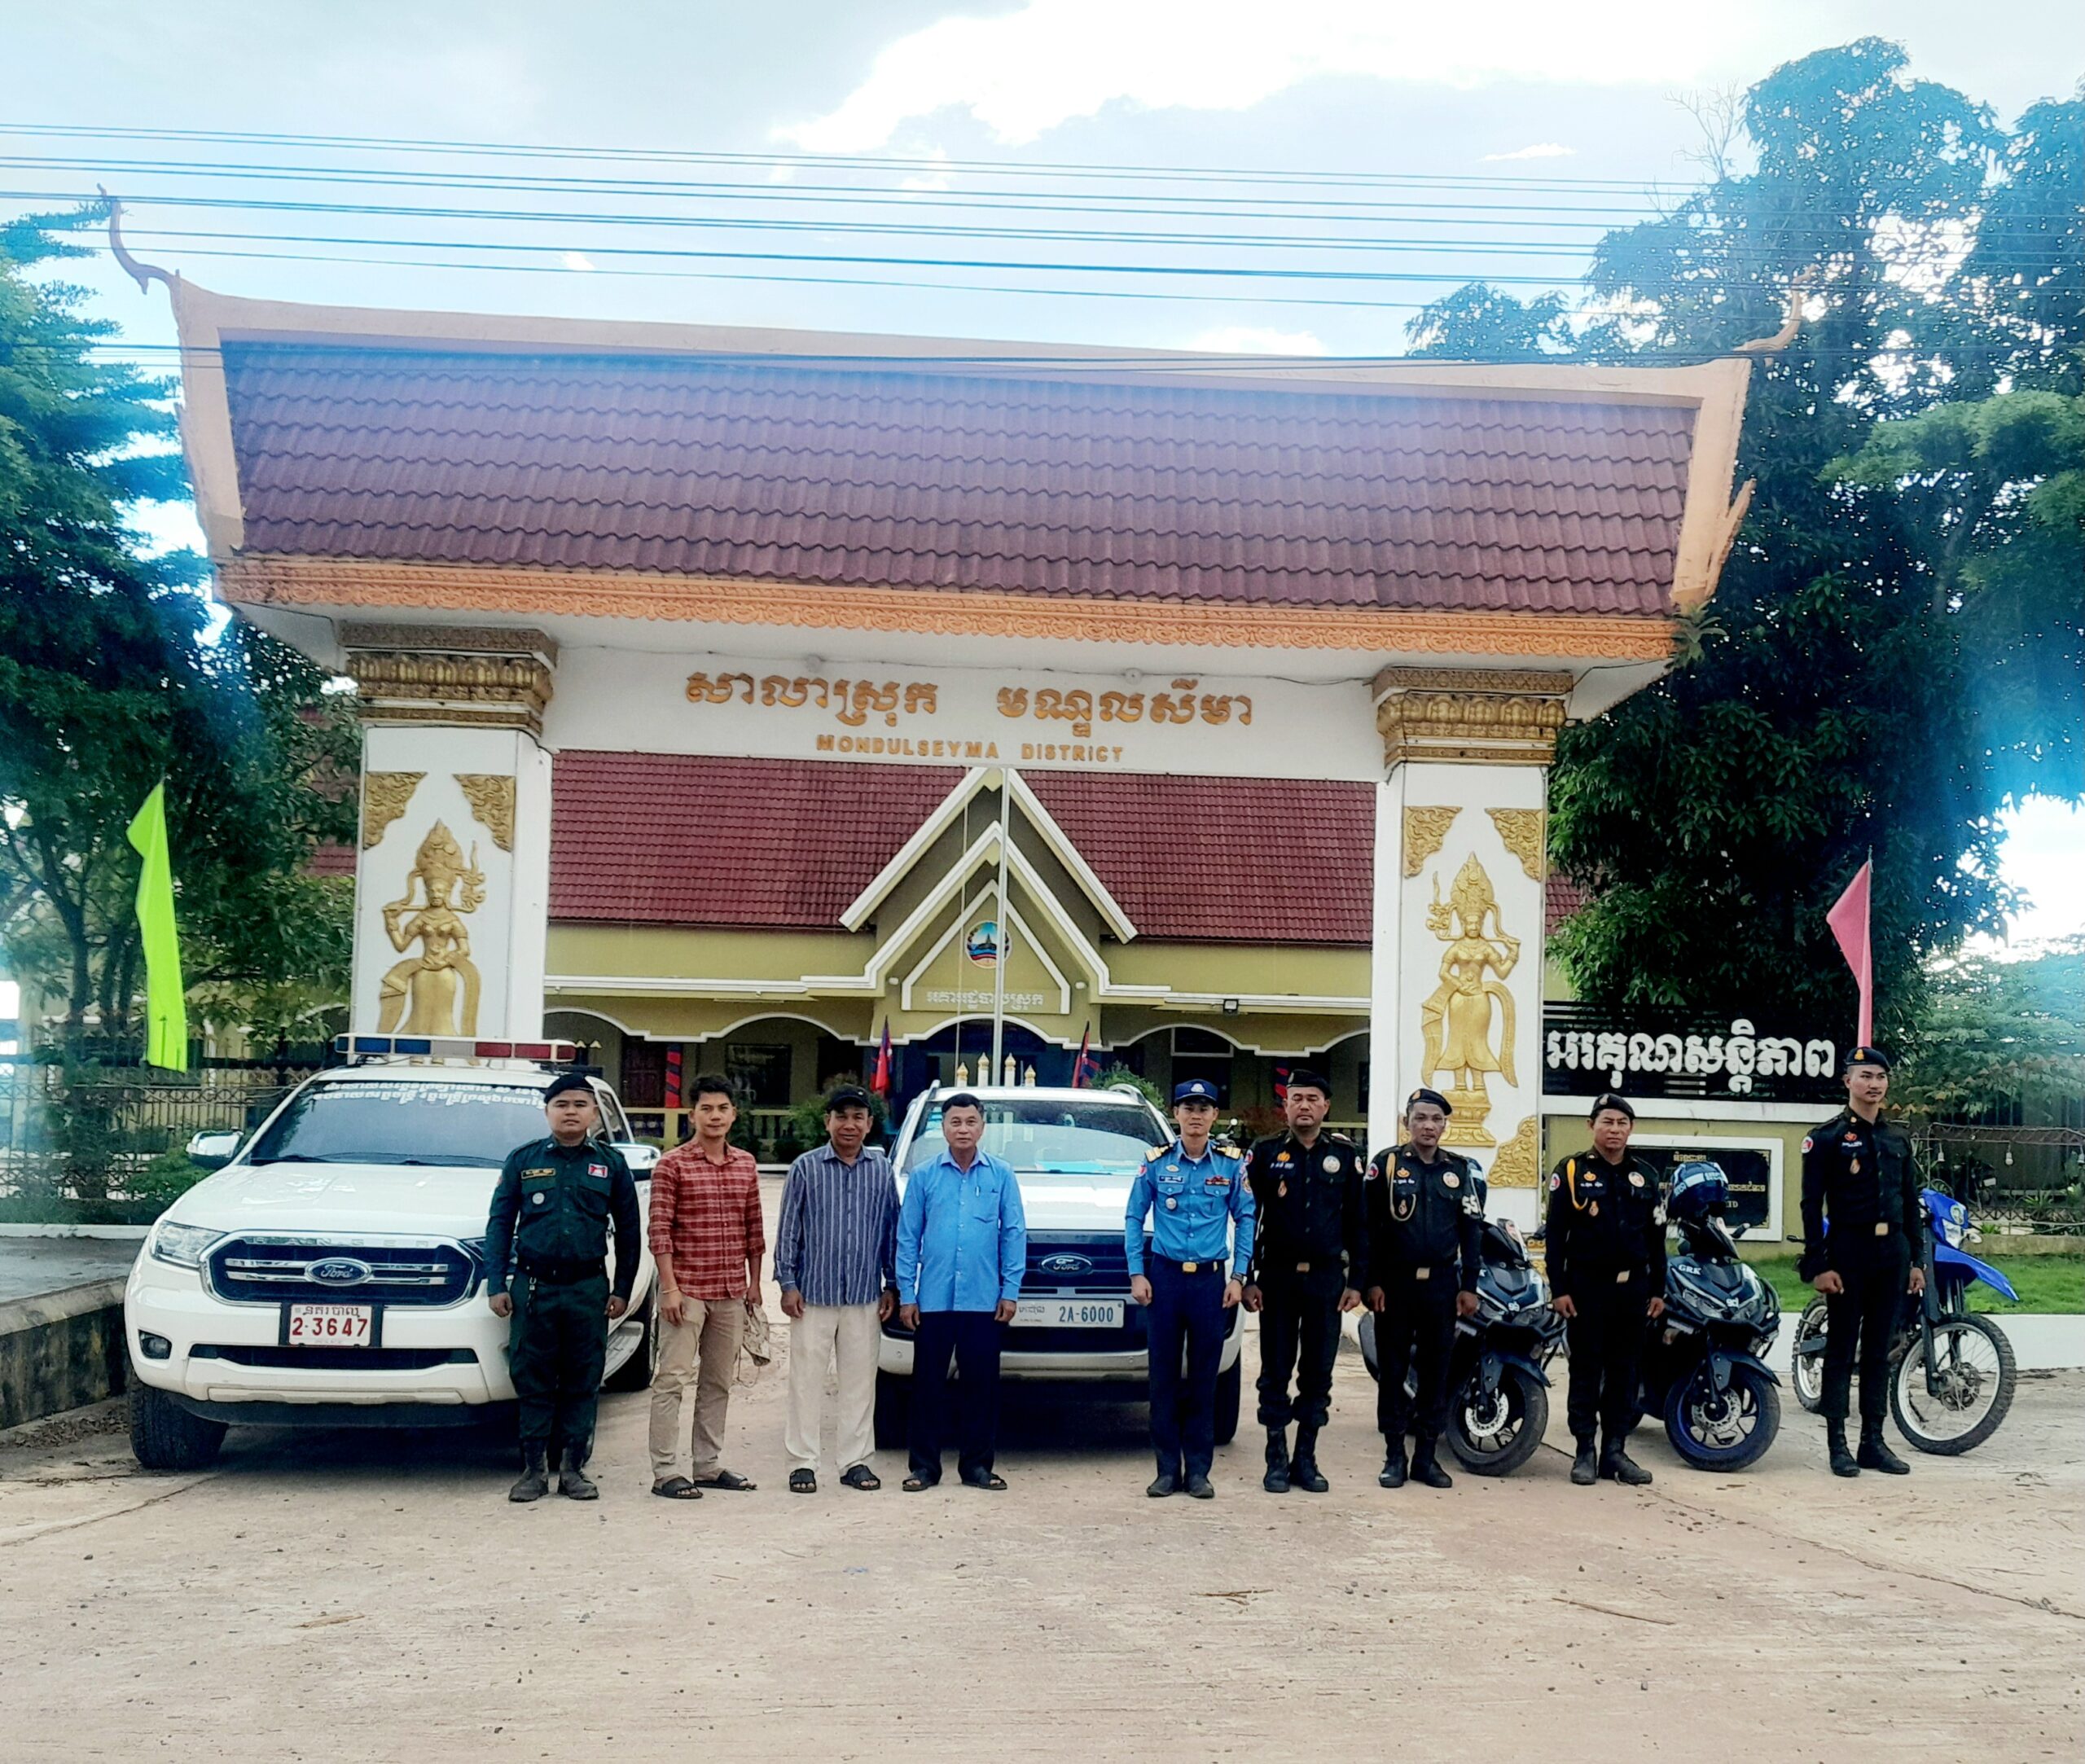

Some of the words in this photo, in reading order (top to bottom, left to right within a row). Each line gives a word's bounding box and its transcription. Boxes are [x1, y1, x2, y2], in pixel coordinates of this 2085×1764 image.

[684, 670, 939, 727] សាលាស្រុក
[996, 679, 1254, 737] មណ្ឌលសីមា
[817, 734, 999, 759] MONDULSEYMA
[1021, 742, 1124, 762] DISTRICT
[320, 1264, 353, 1279] Ford
[1678, 1264, 1702, 1275] GRK
[1059, 1305, 1114, 1323] 2A-6000
[292, 1316, 368, 1337] 2-3647
